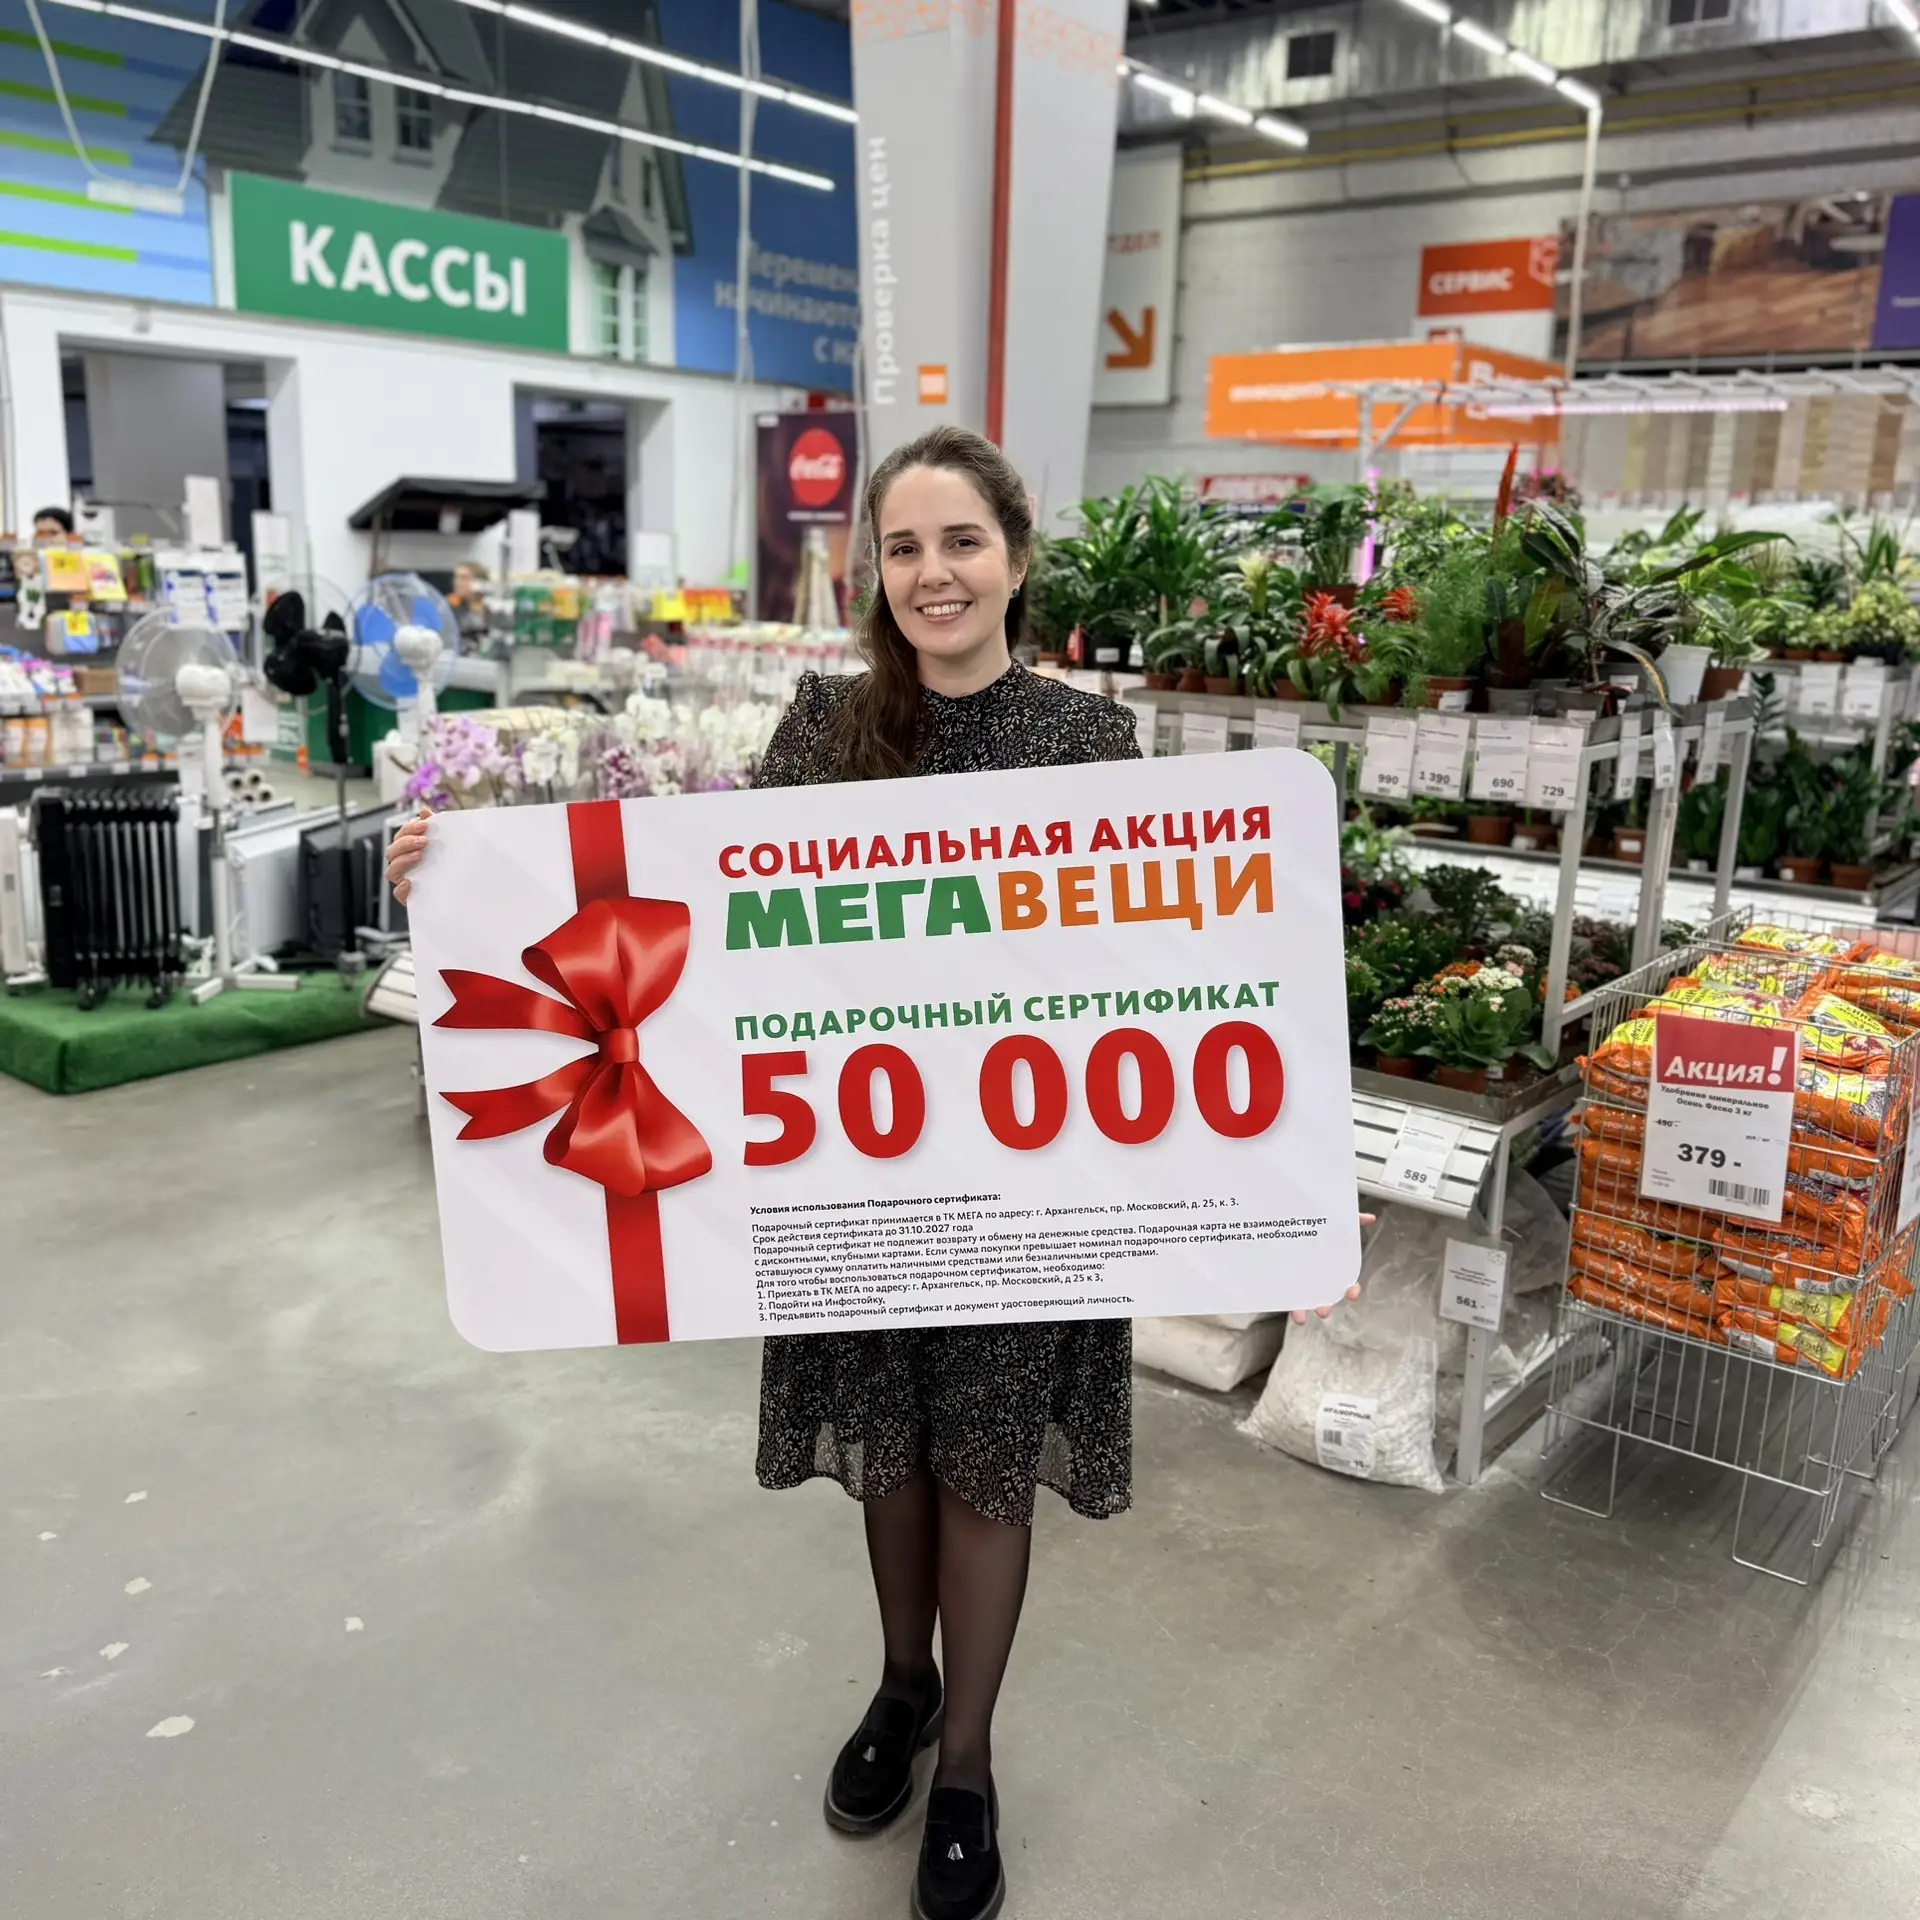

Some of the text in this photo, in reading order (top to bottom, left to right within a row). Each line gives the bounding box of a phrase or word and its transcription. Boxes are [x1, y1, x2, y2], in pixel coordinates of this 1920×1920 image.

[289, 220, 527, 315] КАССЫ
[868, 137, 902, 406] Проверка цен
[1377, 773, 1399, 785] 990
[1429, 772, 1451, 784] 390
[1491, 777, 1515, 789] 690
[1542, 785, 1565, 797] 729
[718, 805, 1272, 879] СОЦИАЛЬНАЯ АКЦИЯ
[735, 981, 1281, 1041] ПОДАРОЧНЫЙ СЕРТИФИКАТ
[741, 1020, 1284, 1166] 50 000
[1661, 1085, 1769, 1109] Удобрение минеральное
[1676, 1097, 1752, 1117] Осень Фаско 3 кг
[1656, 1118, 1673, 1128] 490
[1677, 1143, 1726, 1168] 379
[1404, 1169, 1428, 1183] 589
[750, 1193, 1001, 1215] Условия использования Подарочного сертификата:
[752, 1221, 813, 1233] Подарочный
[814, 1218, 869, 1230] сертификат
[871, 1215, 934, 1227] принимается
[943, 1212, 955, 1221] ТК
[957, 1211, 983, 1220] МЕГА
[998, 1210, 1034, 1220] адресу:
[1044, 1206, 1108, 1217] Архангельск,
[1110, 1205, 1125, 1214] пр.
[1127, 1200, 1189, 1211] Московский,
[1191, 1201, 1200, 1209] д.
[1203, 1198, 1217, 1208] 25,
[1230, 1197, 1239, 1206] 3.
[752, 1235, 776, 1245] Срок
[777, 1232, 821, 1243] действия
[823, 1229, 883, 1241] сертификата
[885, 1228, 897, 1237] до
[898, 1224, 950, 1235] 31.10.2027
[753, 1243, 815, 1255] Подарочный
[816, 1241, 871, 1253] сертификат
[887, 1238, 934, 1249] подлежит
[936, 1236, 977, 1245] возврату
[987, 1232, 1023, 1242] обмену
[1038, 1230, 1089, 1240] денежные
[1091, 1227, 1136, 1238] средства.
[1138, 1224, 1198, 1234] Подарочная
[1200, 1223, 1227, 1232] карта
[1243, 1218, 1327, 1228] взаимодействует
[761, 1256, 829, 1267] дисконтными,
[831, 1252, 880, 1263] клубными
[881, 1250, 923, 1260] картами.
[925, 1248, 947, 1256] Если
[949, 1247, 979, 1257] сумма
[981, 1245, 1021, 1255] покупки
[1023, 1242, 1077, 1255] превышает
[1079, 1239, 1122, 1248] номинал
[1124, 1236, 1187, 1247] подарочного
[1189, 1233, 1255, 1244] сертификата,
[1257, 1229, 1318, 1239] необходимо
[1617, 1240, 1638, 1257] 2X
[755, 1267, 813, 1278] оставшуюся
[814, 1266, 844, 1276] сумму
[845, 1263, 888, 1272] оплатить
[890, 1260, 946, 1269] наличными
[947, 1257, 1003, 1268] средствами
[1025, 1252, 1098, 1262] безналичными
[1099, 1249, 1159, 1260] средствами.
[756, 1262, 1105, 1289] Для того чтобы воспользоваться подарочном сертификатом, необходимо:
[757, 1291, 766, 1299] 1.
[767, 1290, 812, 1300] Приехать
[820, 1287, 833, 1295] ТК
[834, 1285, 861, 1294] МЕГА
[876, 1284, 911, 1293] адресу:
[921, 1281, 983, 1292] Архангельск,
[985, 1279, 1000, 1288] пр.
[1001, 1275, 1063, 1285] Московский,
[1065, 1276, 1071, 1284] д
[1073, 1274, 1085, 1282] 25
[1094, 1273, 1103, 1282] 3,
[758, 1302, 767, 1310] 2.
[768, 1300, 810, 1310] Подойти
[825, 1296, 886, 1307] Инфостойку,
[759, 1313, 768, 1322] 3.
[769, 1312, 826, 1322] Предъявить
[827, 1306, 887, 1318] подарочный
[888, 1304, 943, 1315] сертификат
[954, 1302, 999, 1312] документ
[1001, 1296, 1085, 1311] удостоверяющий
[1087, 1296, 1134, 1304] личность.
[1456, 1295, 1477, 1309] 561
